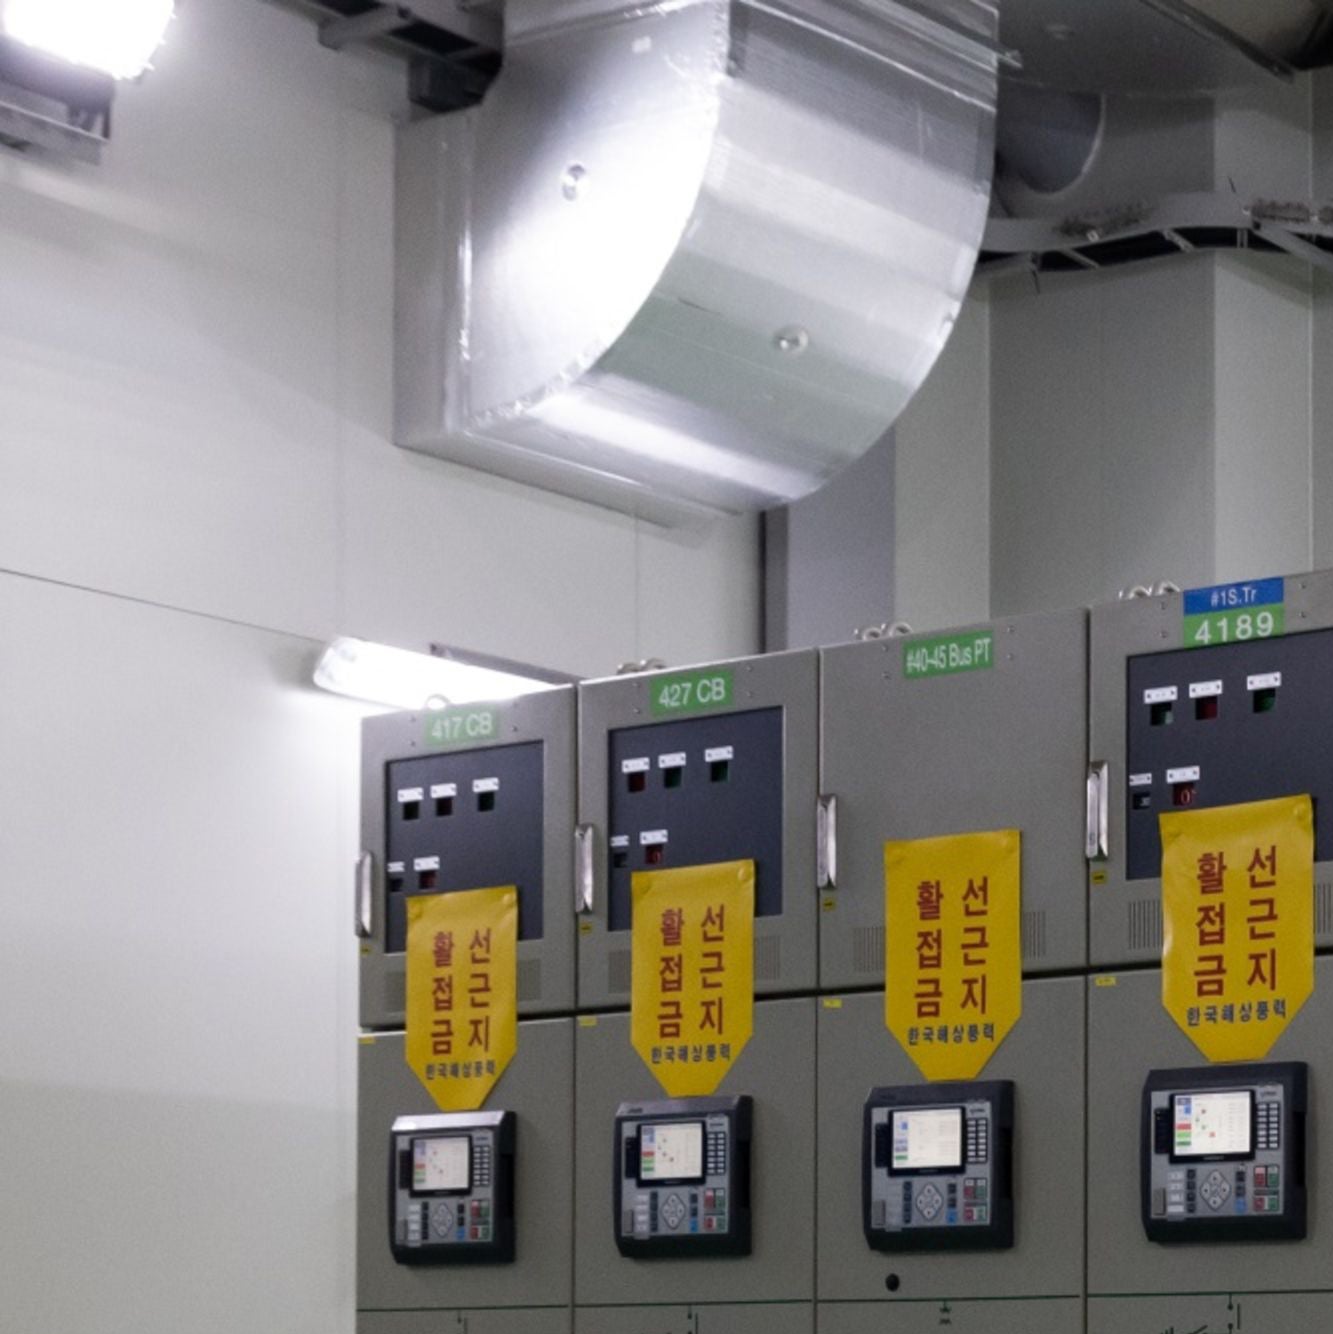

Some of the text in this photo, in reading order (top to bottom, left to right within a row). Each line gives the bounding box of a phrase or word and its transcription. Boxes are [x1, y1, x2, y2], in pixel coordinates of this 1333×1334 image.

[1210, 586, 1257, 607] #1S.Tr
[1194, 611, 1274, 646] 4189
[906, 637, 991, 674] #40-45 Bus PT
[658, 677, 726, 708] 427 CB
[431, 711, 493, 741] 417 CB
[1186, 999, 1287, 1027] 한국해상풍력
[907, 1023, 995, 1046] 한국해상풍력
